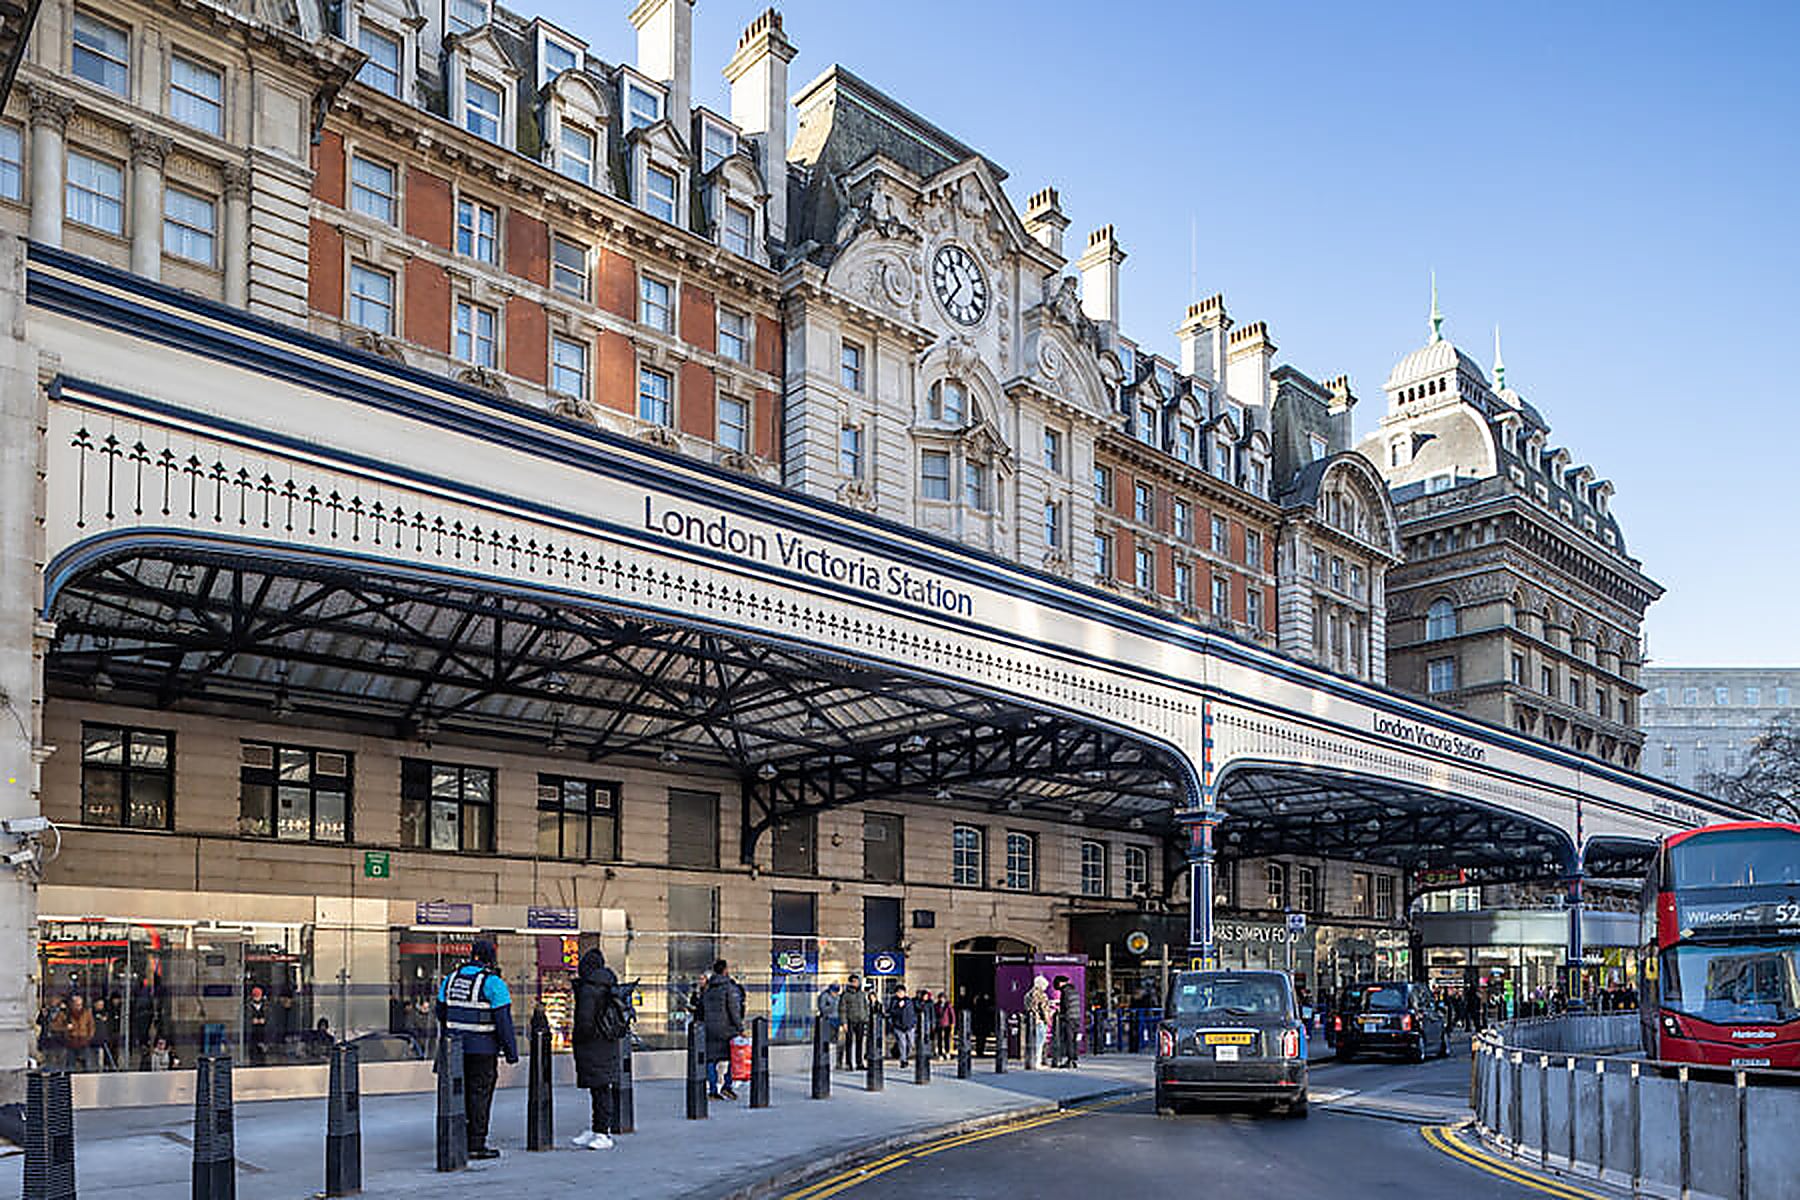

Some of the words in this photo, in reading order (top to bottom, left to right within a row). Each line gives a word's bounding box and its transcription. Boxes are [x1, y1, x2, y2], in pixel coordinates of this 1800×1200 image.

[645, 495, 767, 560] London
[776, 532, 881, 591] Victoria
[887, 566, 974, 616] Station
[1373, 712, 1414, 740] London
[1415, 725, 1452, 753] Victoria
[1453, 737, 1485, 760] Station
[1775, 904, 1800, 922] 52
[1236, 926, 1271, 942] SIMPLY
[1273, 927, 1299, 943] FOD
